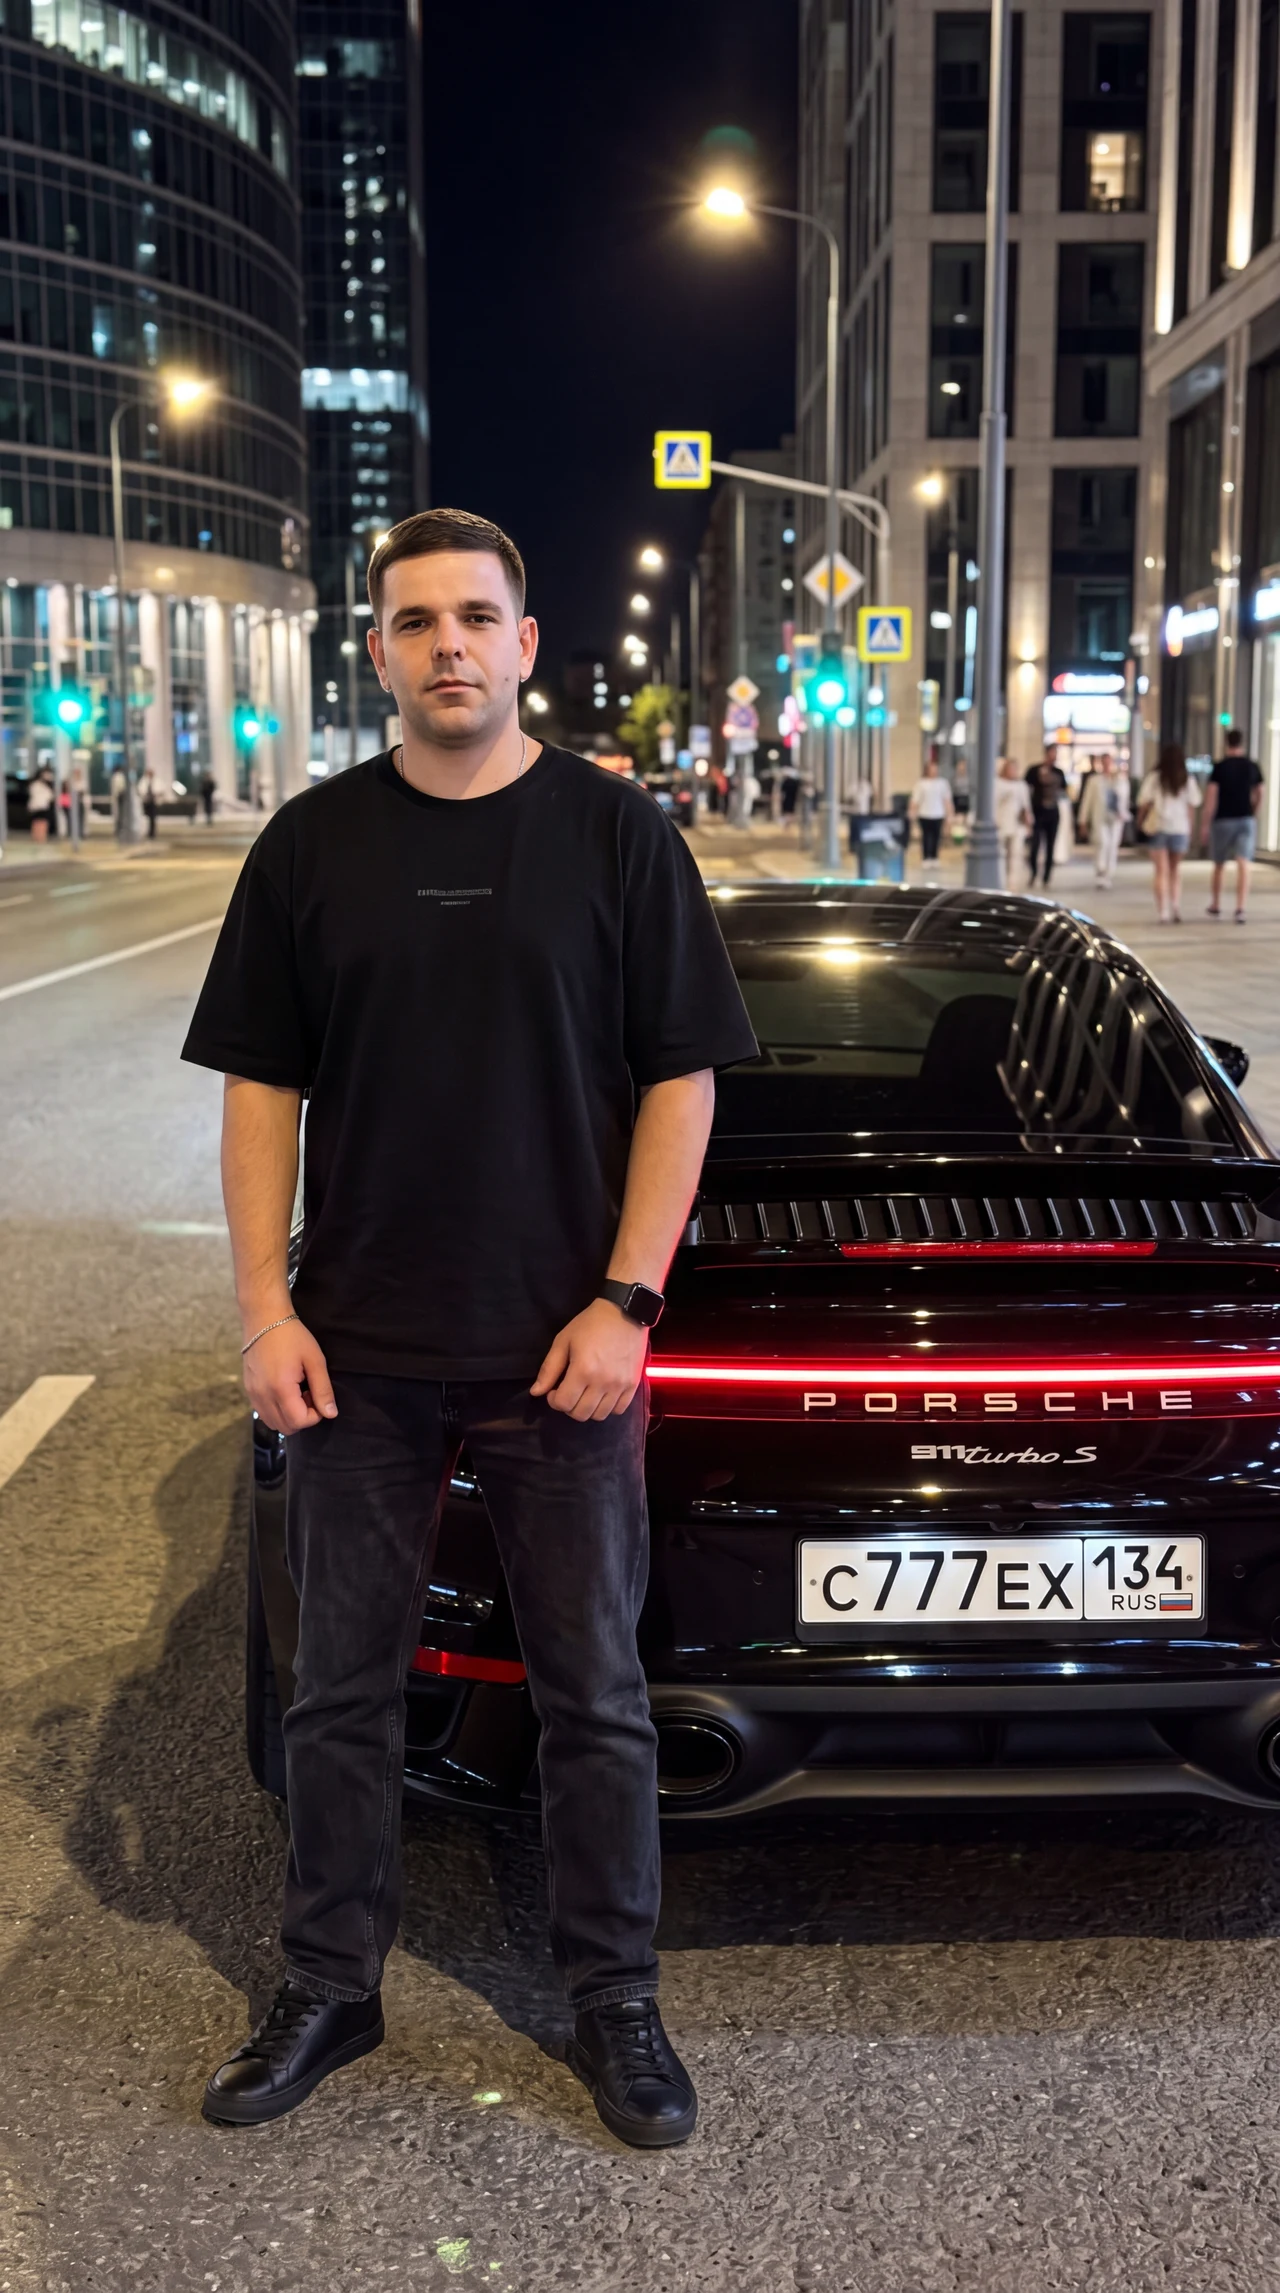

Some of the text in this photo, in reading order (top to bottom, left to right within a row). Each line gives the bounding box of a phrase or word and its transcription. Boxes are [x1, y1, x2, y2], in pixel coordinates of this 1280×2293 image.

[804, 1391, 1193, 1412] PORSCHE
[1063, 1446, 1097, 1464] S
[1092, 1545, 1183, 1590] 134
[1112, 1594, 1157, 1611] RUS
